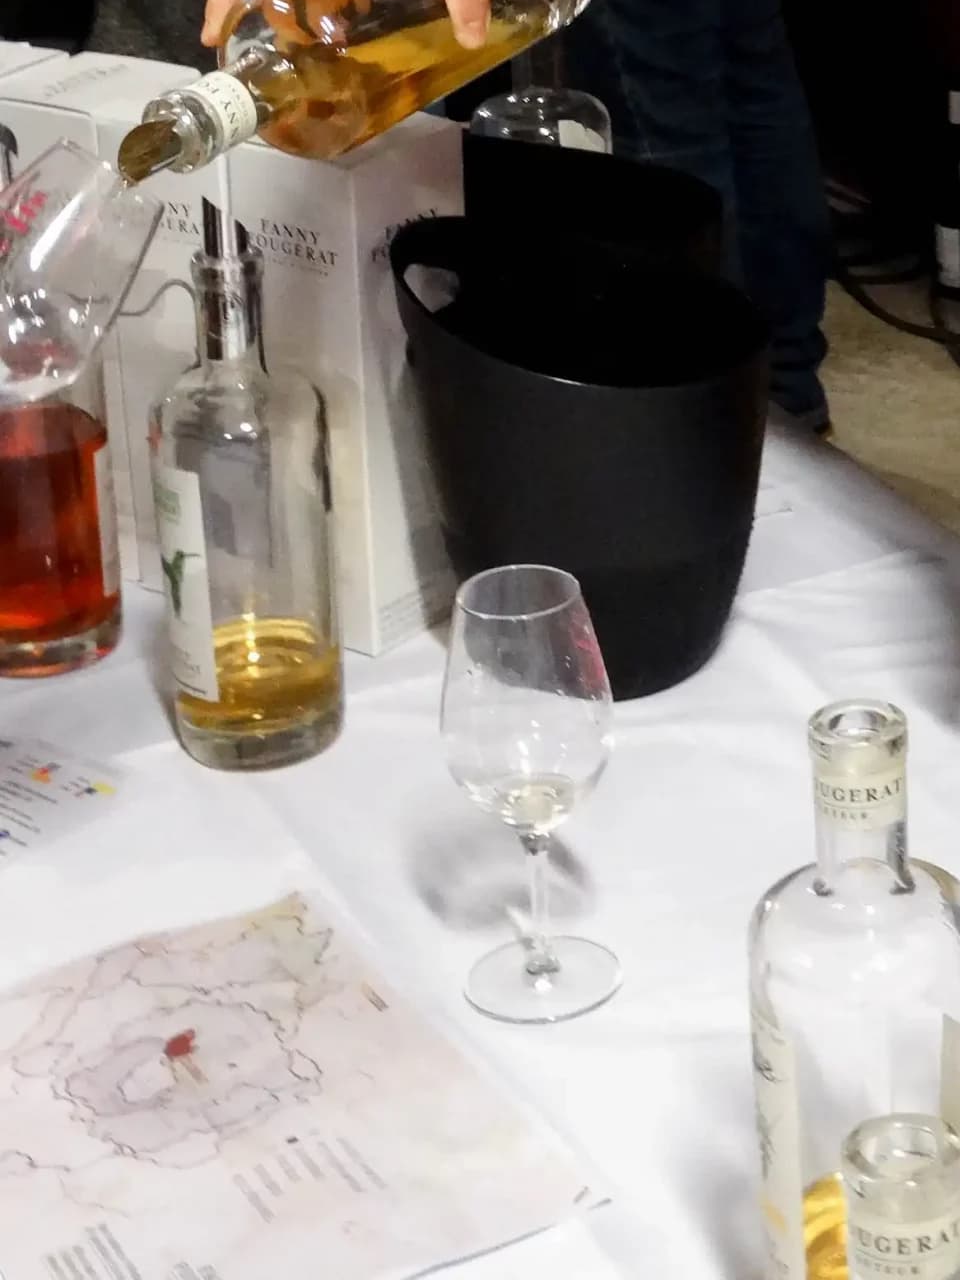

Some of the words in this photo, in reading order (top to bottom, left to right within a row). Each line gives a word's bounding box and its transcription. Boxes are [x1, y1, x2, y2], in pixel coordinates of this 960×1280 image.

[260, 218, 320, 245] FANNY
[255, 233, 338, 266] OUGERAT
[814, 776, 903, 802] UGERAT
[856, 1221, 960, 1255] UGERAT
